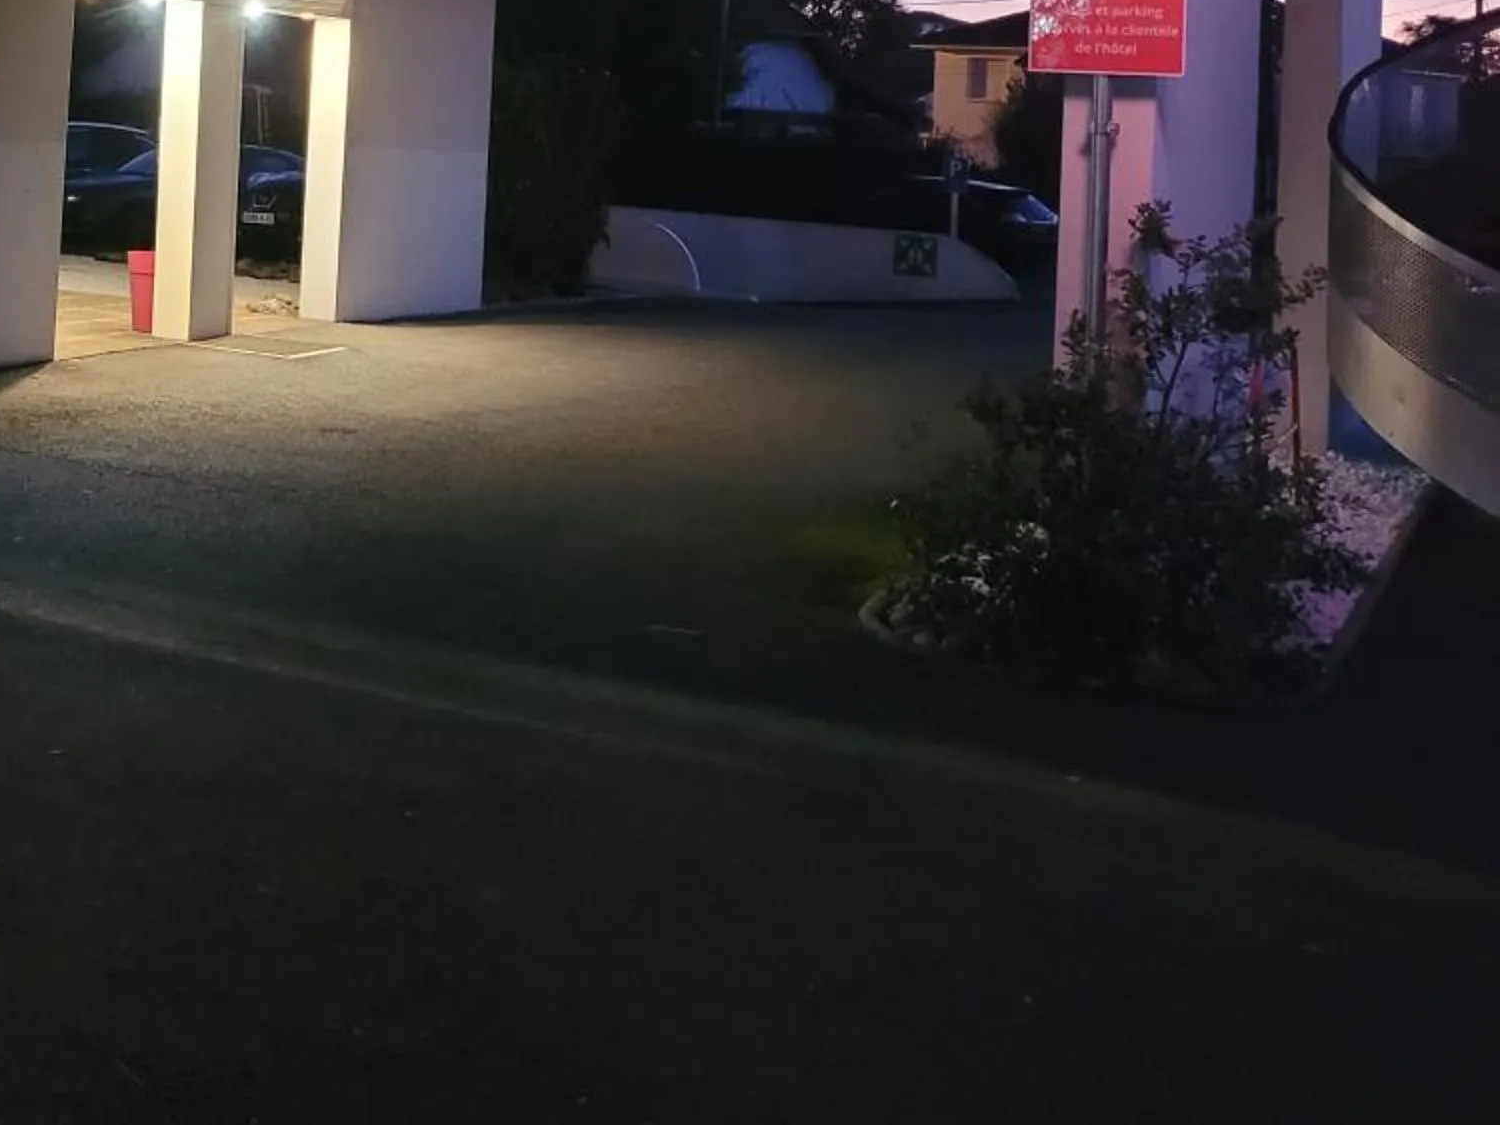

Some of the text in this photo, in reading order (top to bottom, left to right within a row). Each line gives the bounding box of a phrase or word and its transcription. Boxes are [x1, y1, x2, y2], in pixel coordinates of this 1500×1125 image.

[1095, 6, 1109, 17] et
[1111, 4, 1165, 21] parking
[1105, 23, 1119, 36] la
[1074, 41, 1092, 54] de
